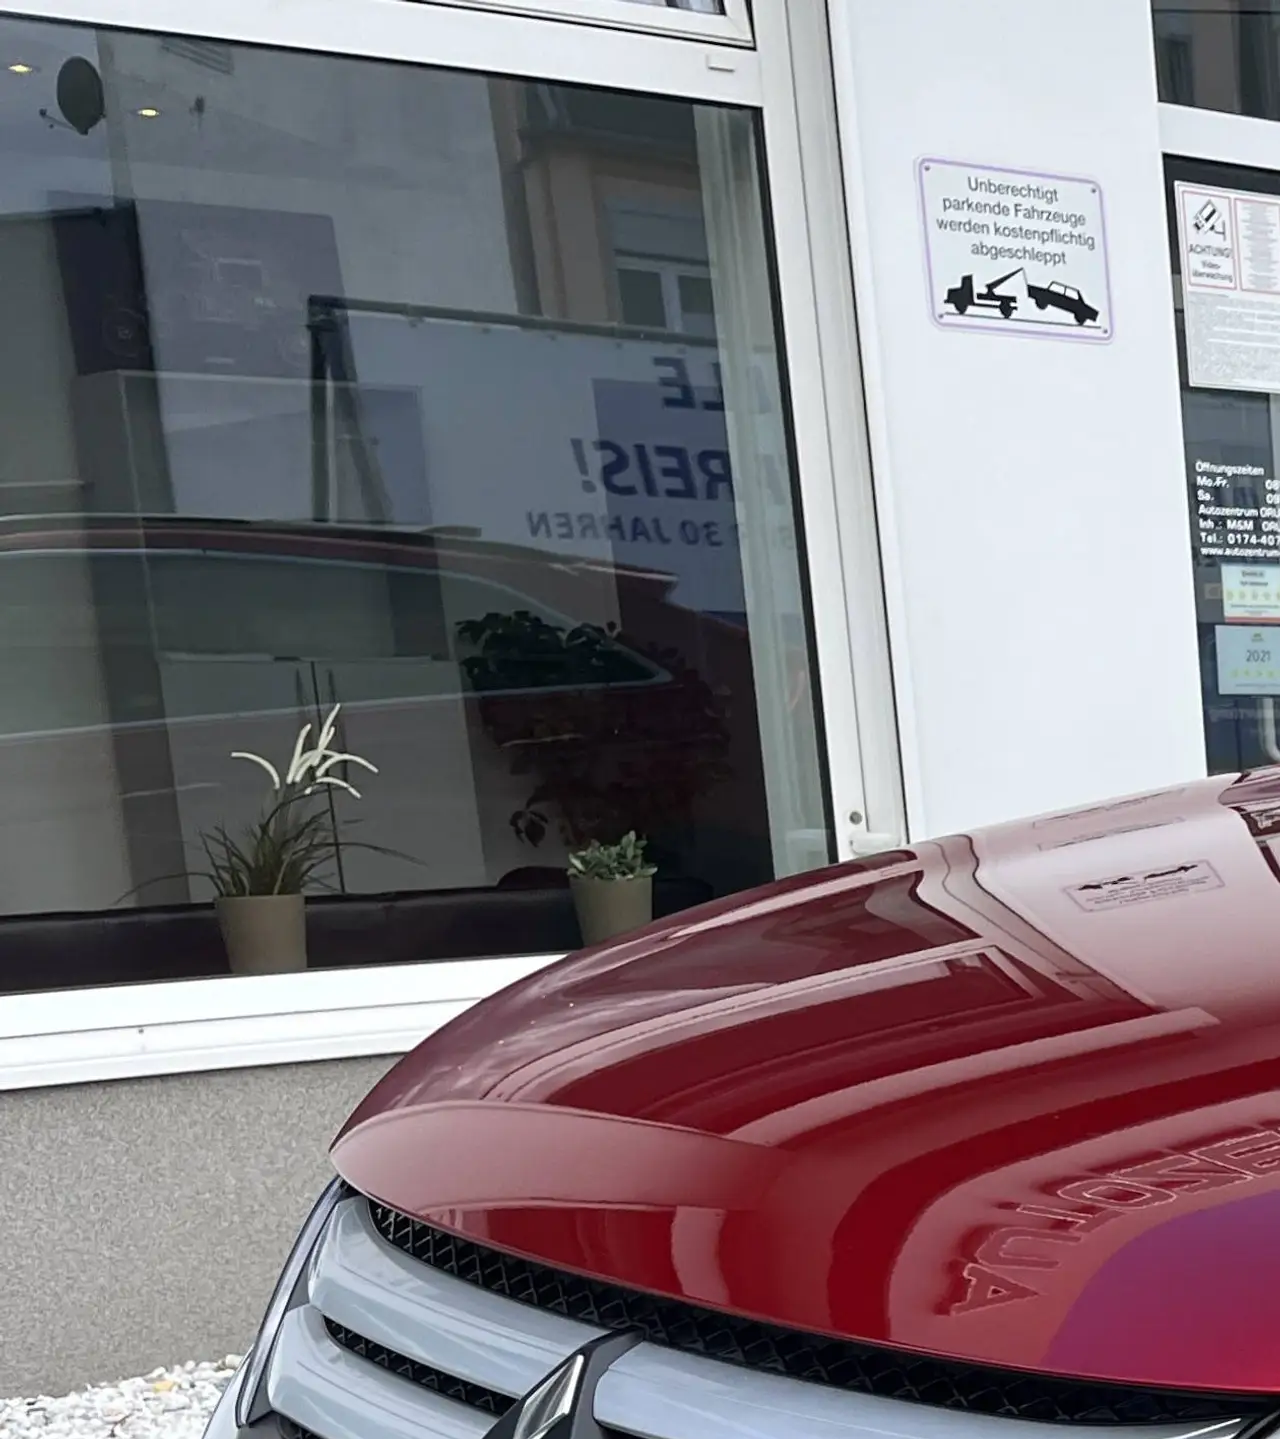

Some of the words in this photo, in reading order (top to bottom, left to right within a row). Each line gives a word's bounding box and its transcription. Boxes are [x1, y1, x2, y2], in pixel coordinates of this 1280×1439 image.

[967, 176, 1059, 204] Unberechtigt
[942, 197, 1010, 218] parkende
[1013, 203, 1086, 228] Fahrzeuge
[935, 217, 990, 236] werden
[993, 222, 1096, 251] kostenpflichtig
[970, 242, 1067, 266] abgeschleppt
[1198, 504, 1259, 518] Autozentrum
[1245, 649, 1271, 663] 2021
